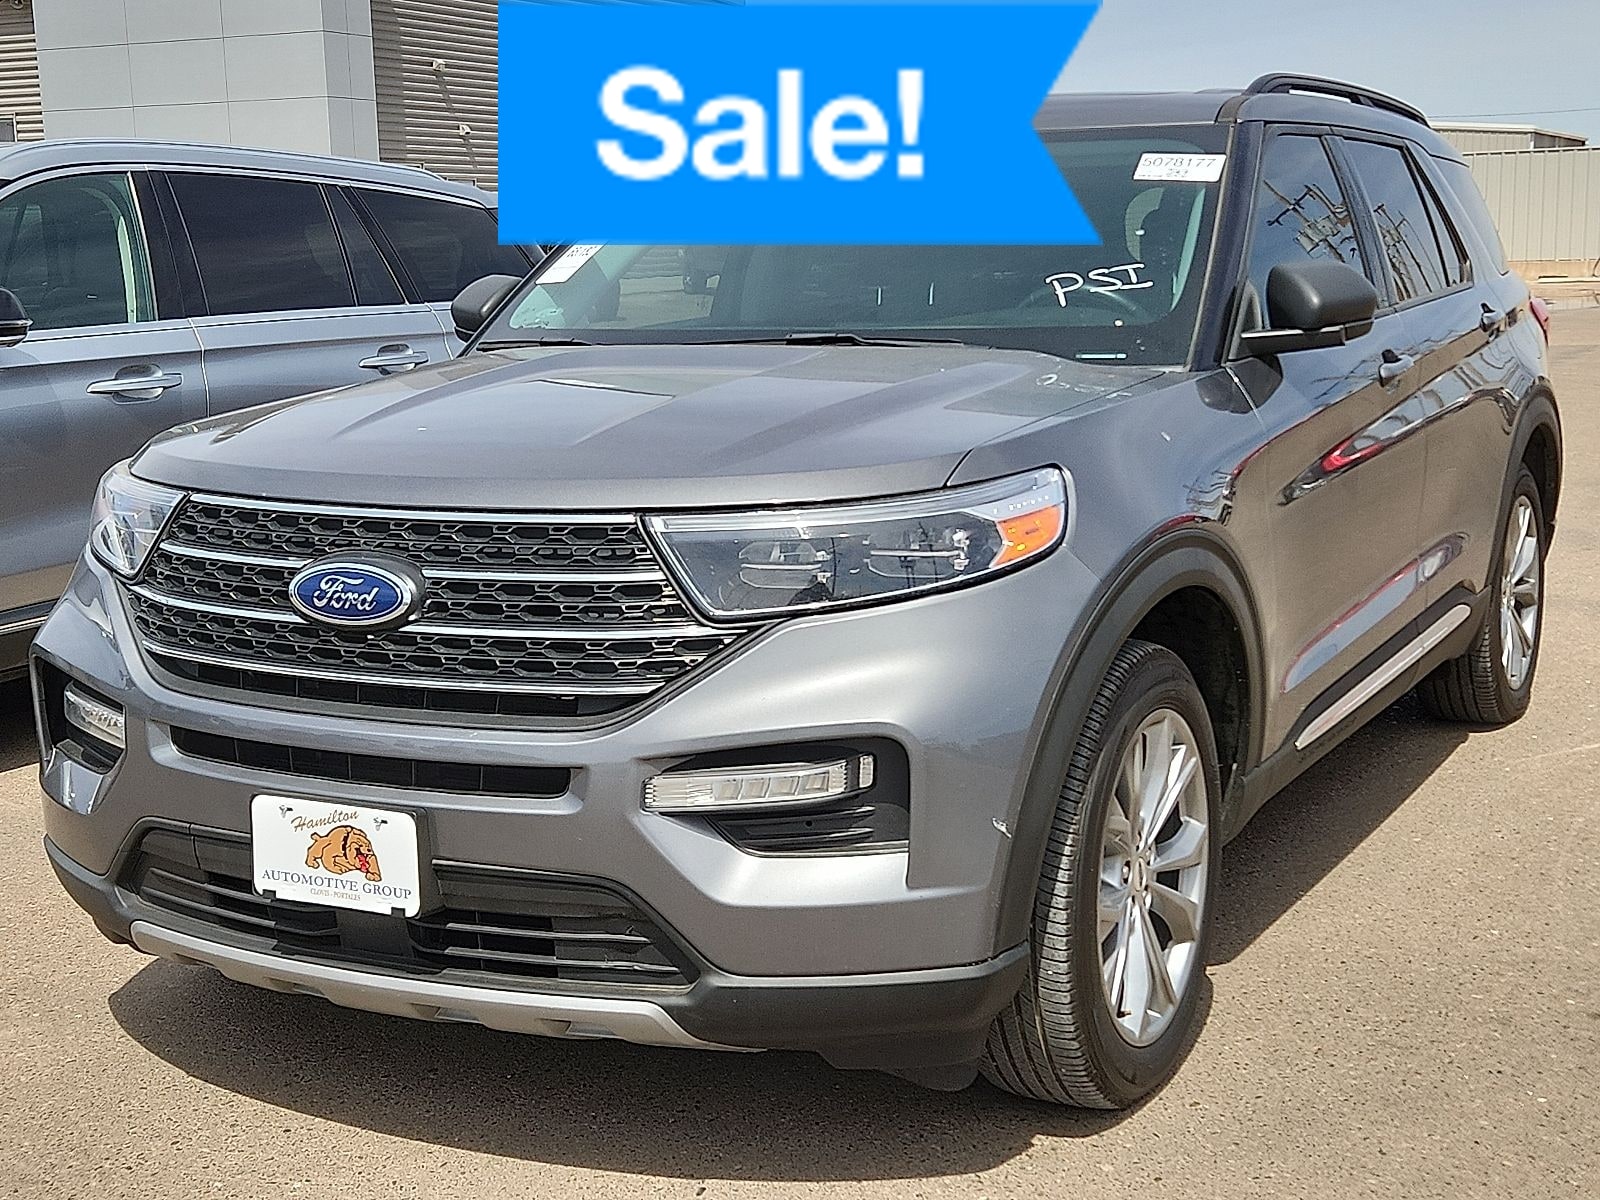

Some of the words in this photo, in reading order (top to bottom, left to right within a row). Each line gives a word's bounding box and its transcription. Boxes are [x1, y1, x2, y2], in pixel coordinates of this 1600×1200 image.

[1045, 263, 1153, 308] PSI
[313, 574, 379, 611] Ford
[290, 809, 360, 833] Hamilton
[261, 869, 358, 892] AUTOMOTIVE
[362, 882, 412, 900] GROUP
